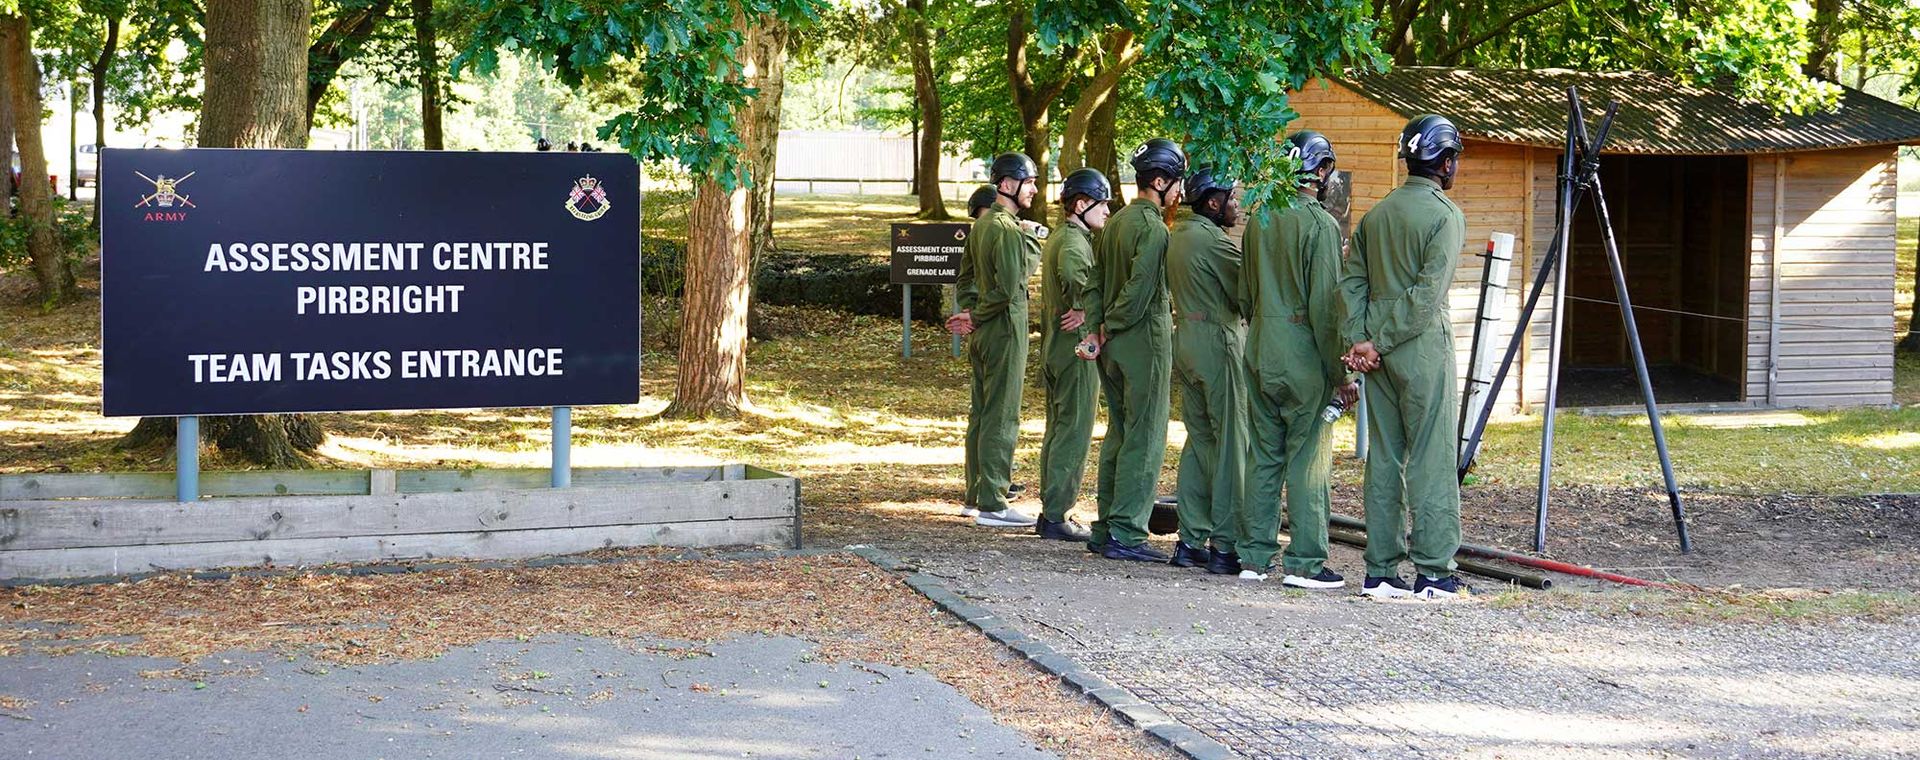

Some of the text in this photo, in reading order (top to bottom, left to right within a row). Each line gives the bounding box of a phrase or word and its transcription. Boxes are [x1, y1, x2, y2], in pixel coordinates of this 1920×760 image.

[144, 211, 187, 221] ARMY
[896, 245, 940, 253] ASSESSMENT
[203, 242, 549, 272] ASSESSMENT CENTRE
[914, 255, 949, 263] PIRBRIGHT
[906, 268, 956, 276] GRENADE LANE
[297, 285, 465, 315] PIRBRIGHT
[187, 348, 563, 383] TEAM TASKS ENTRANCE
